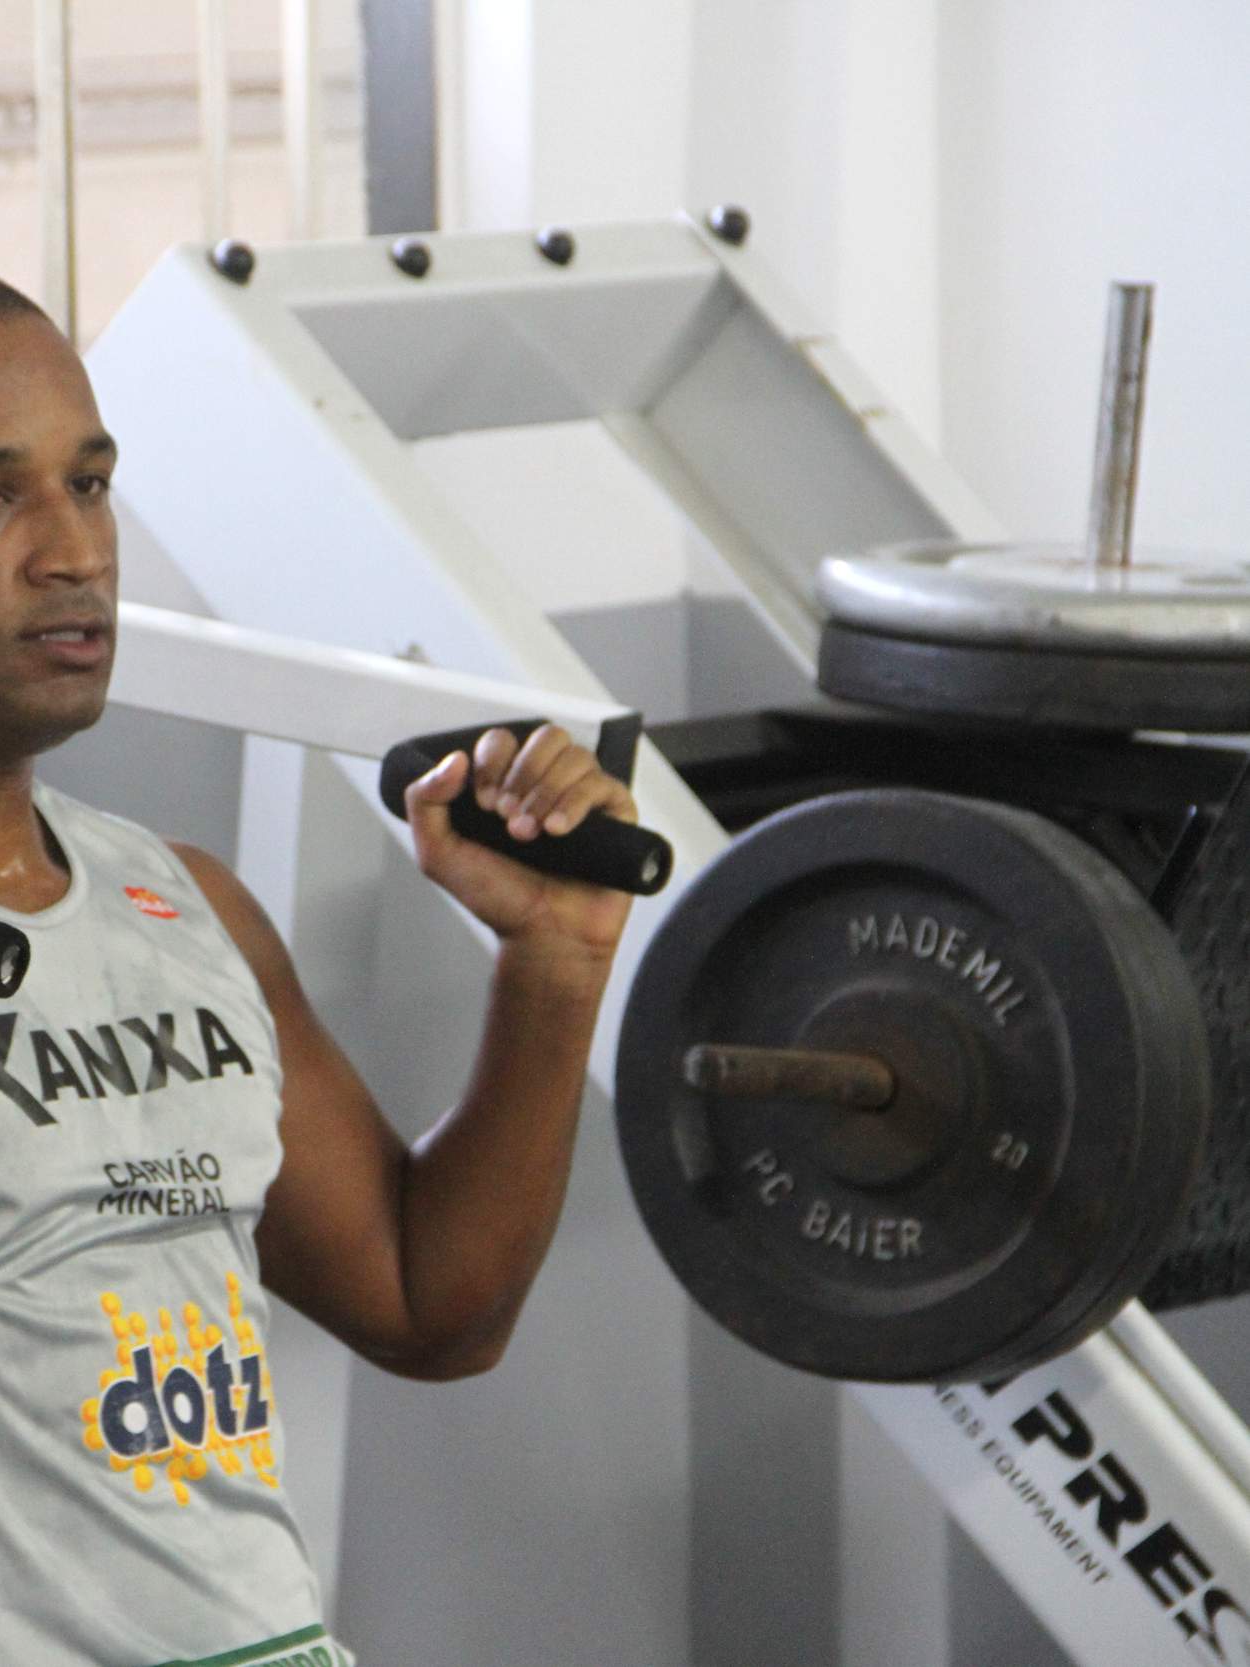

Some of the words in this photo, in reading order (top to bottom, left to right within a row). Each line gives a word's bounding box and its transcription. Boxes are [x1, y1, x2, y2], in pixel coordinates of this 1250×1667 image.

[849, 913, 1026, 1027] MADEMIL
[97, 1186, 230, 1216] MINERAL
[103, 1149, 221, 1187] CARVÃO
[745, 1149, 794, 1206] PC
[802, 1200, 924, 1260] BAIER
[993, 1133, 1029, 1170] 20
[100, 1344, 270, 1457] dotz
[981, 1438, 1111, 1585] EQUIPAMENT
